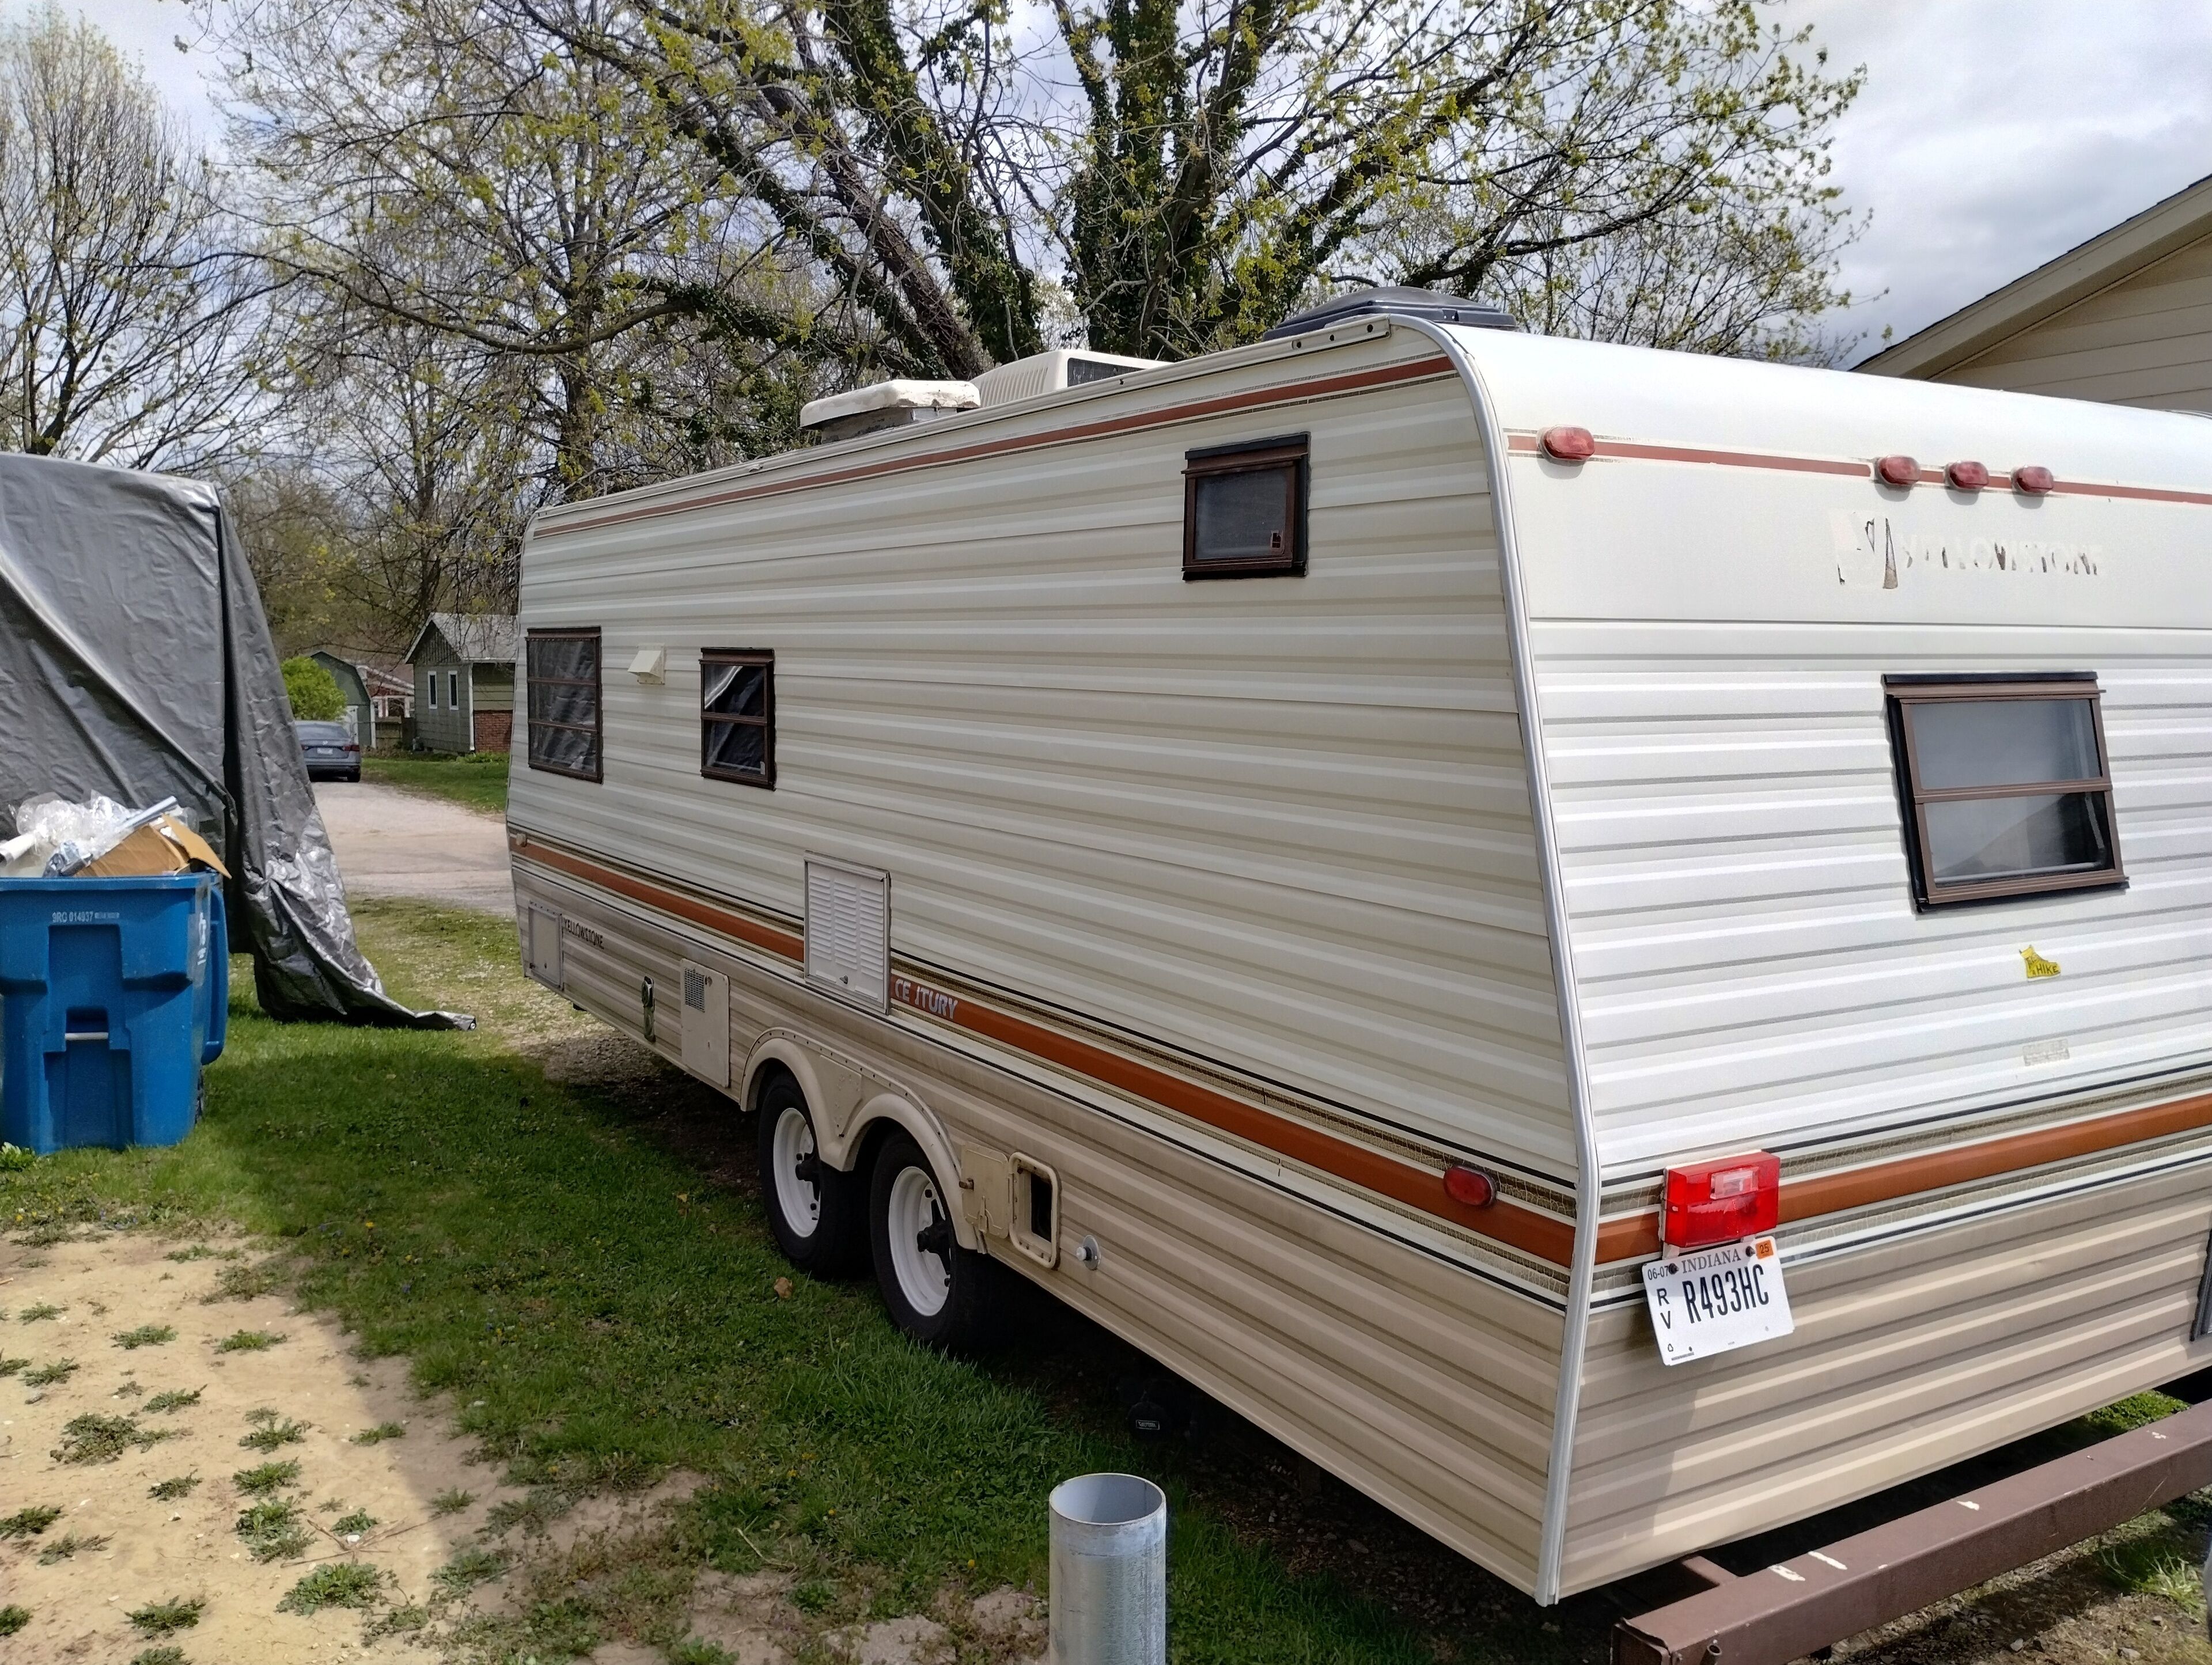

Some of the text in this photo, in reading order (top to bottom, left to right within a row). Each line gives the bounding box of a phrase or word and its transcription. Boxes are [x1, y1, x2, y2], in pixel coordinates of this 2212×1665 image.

[564, 917, 604, 949] YELLOWSTONE
[2036, 963, 2059, 974] HIKE
[1759, 1243, 1769, 1254] 25
[1681, 1248, 1741, 1273] INDIANA
[1647, 1265, 1669, 1280] 06-07
[1682, 1264, 1769, 1324] R493HC
